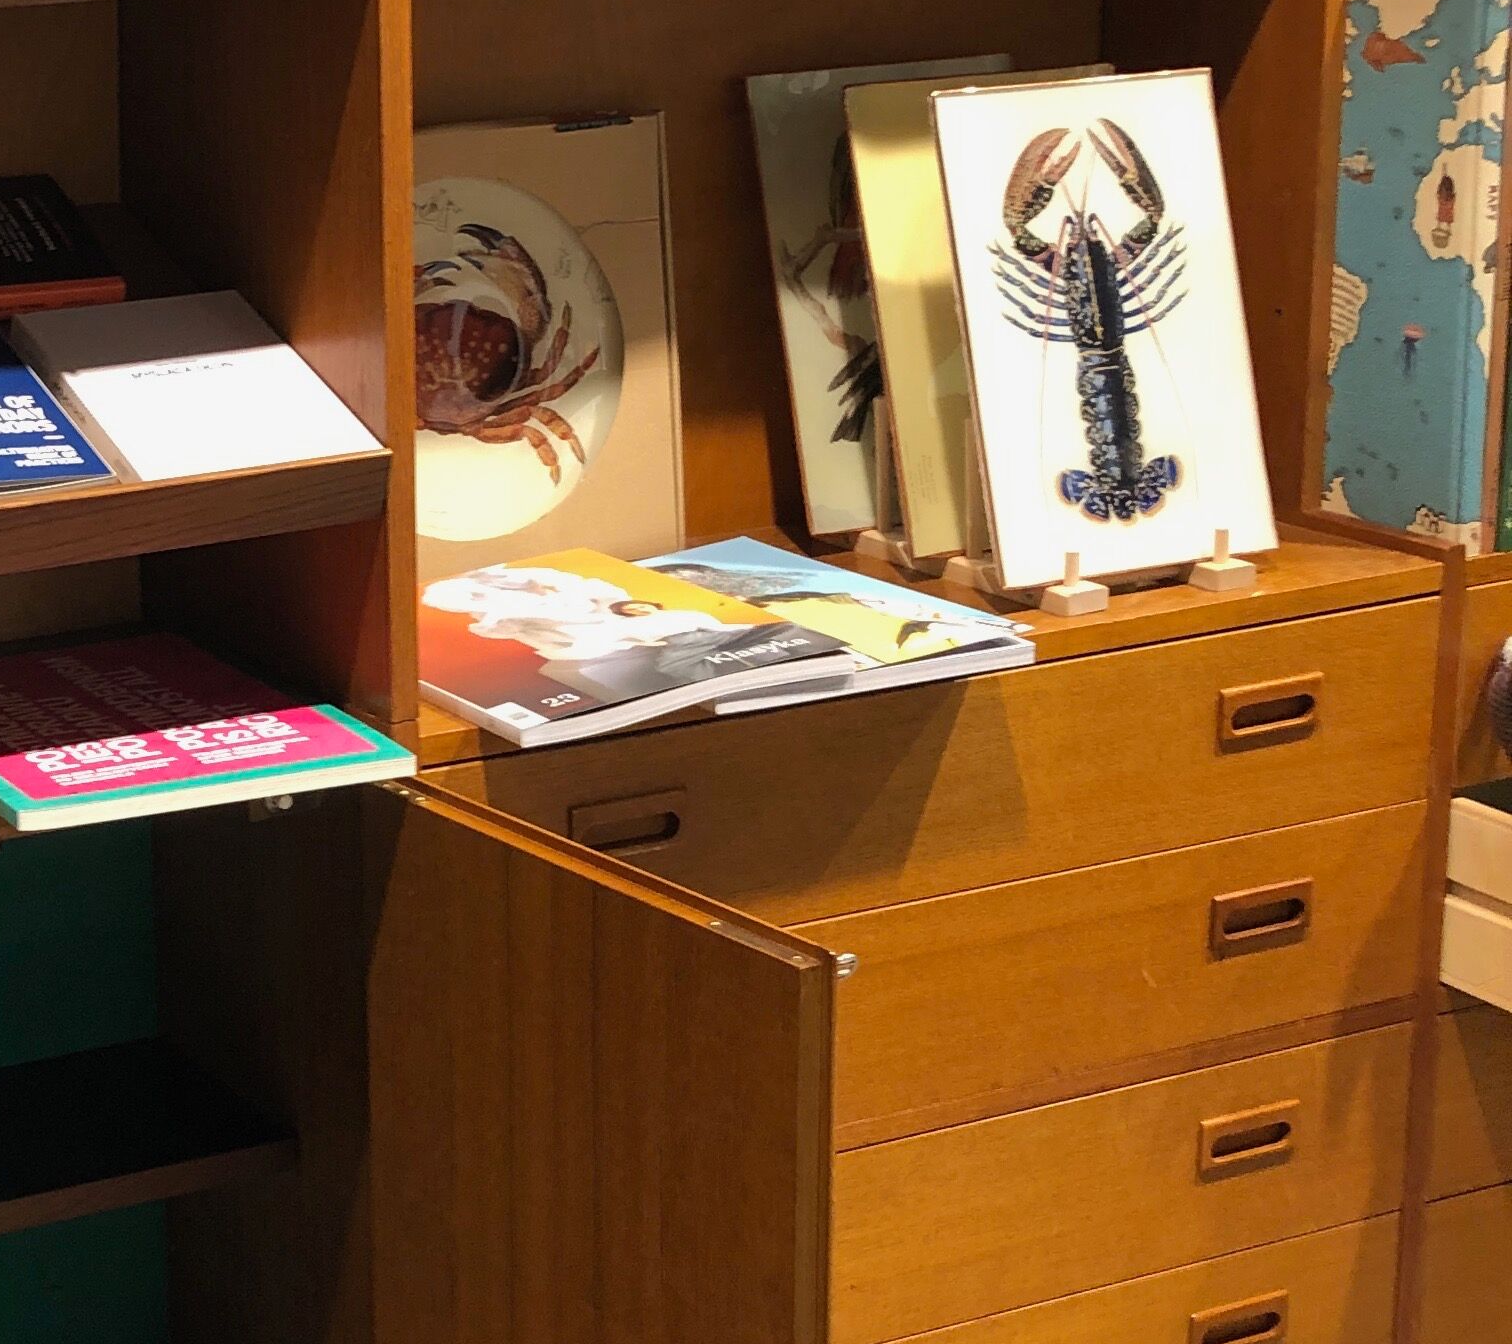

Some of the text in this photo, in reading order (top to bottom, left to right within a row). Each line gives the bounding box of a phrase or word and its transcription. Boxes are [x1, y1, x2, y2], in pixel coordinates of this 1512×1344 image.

[3, 395, 36, 409] OF
[704, 637, 811, 665] Klasyka
[540, 693, 581, 708] 23
[209, 728, 262, 744] IS
